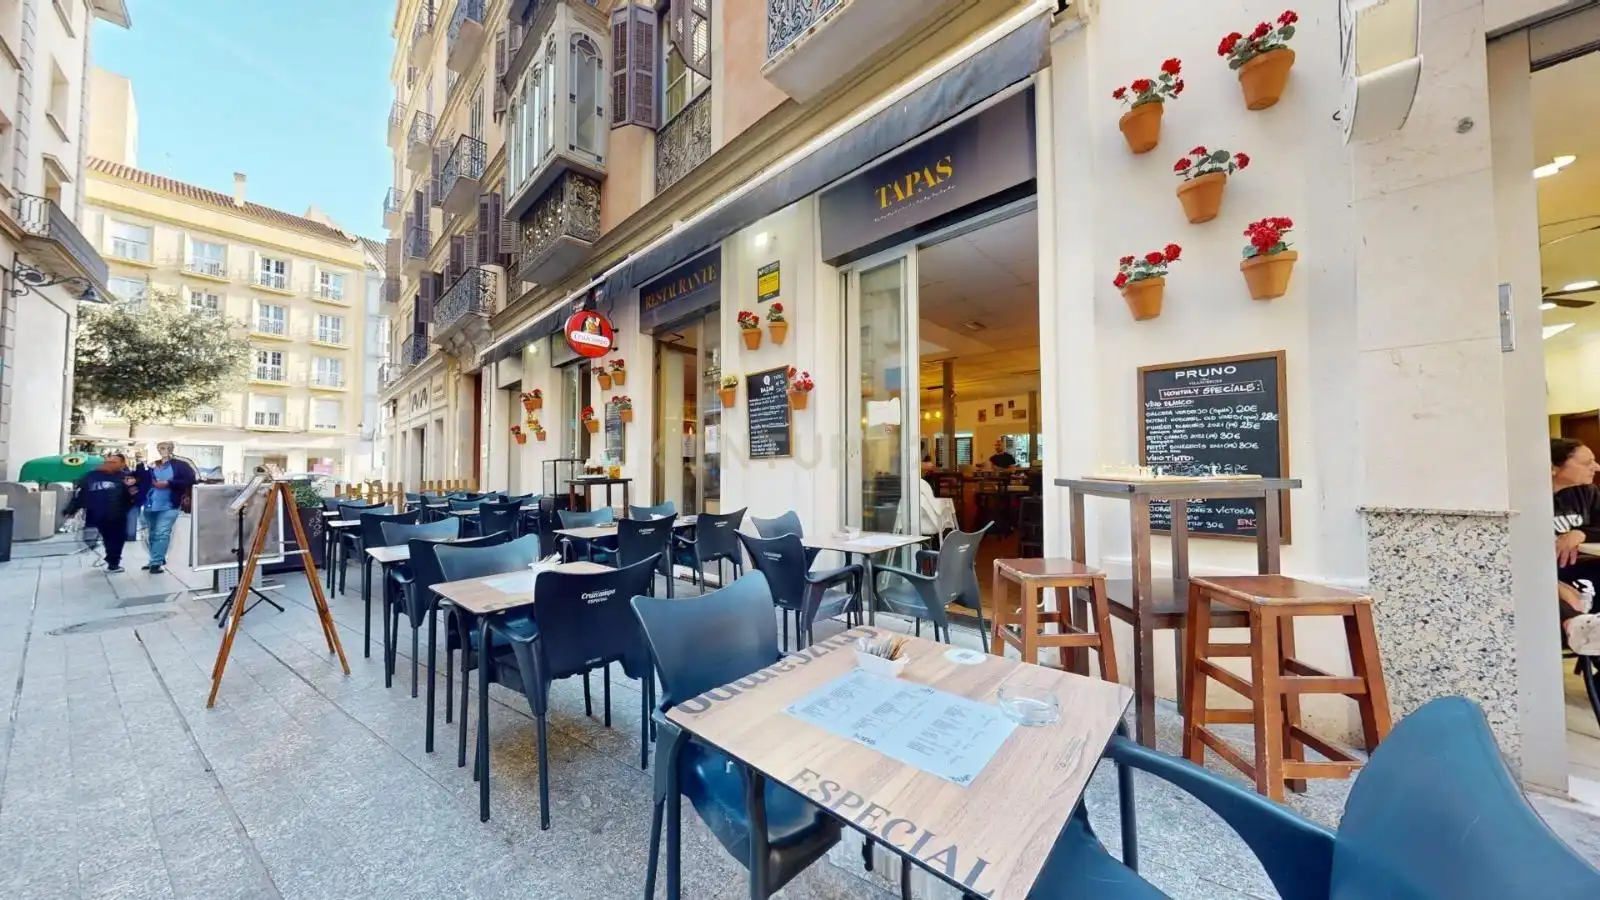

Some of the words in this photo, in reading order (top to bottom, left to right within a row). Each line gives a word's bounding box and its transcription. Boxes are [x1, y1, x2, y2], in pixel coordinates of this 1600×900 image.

[875, 155, 953, 209] TAPAS
[644, 263, 717, 310] RESTAURANTE
[1175, 365, 1237, 380] PRUNO
[1163, 388, 1199, 397] MONTHLY
[1236, 405, 1258, 413] 20€
[1240, 421, 1261, 430] 25€
[1219, 432, 1241, 440] 30€
[581, 588, 616, 601] Cruzcampo
[789, 767, 996, 899] ESPECIAL
